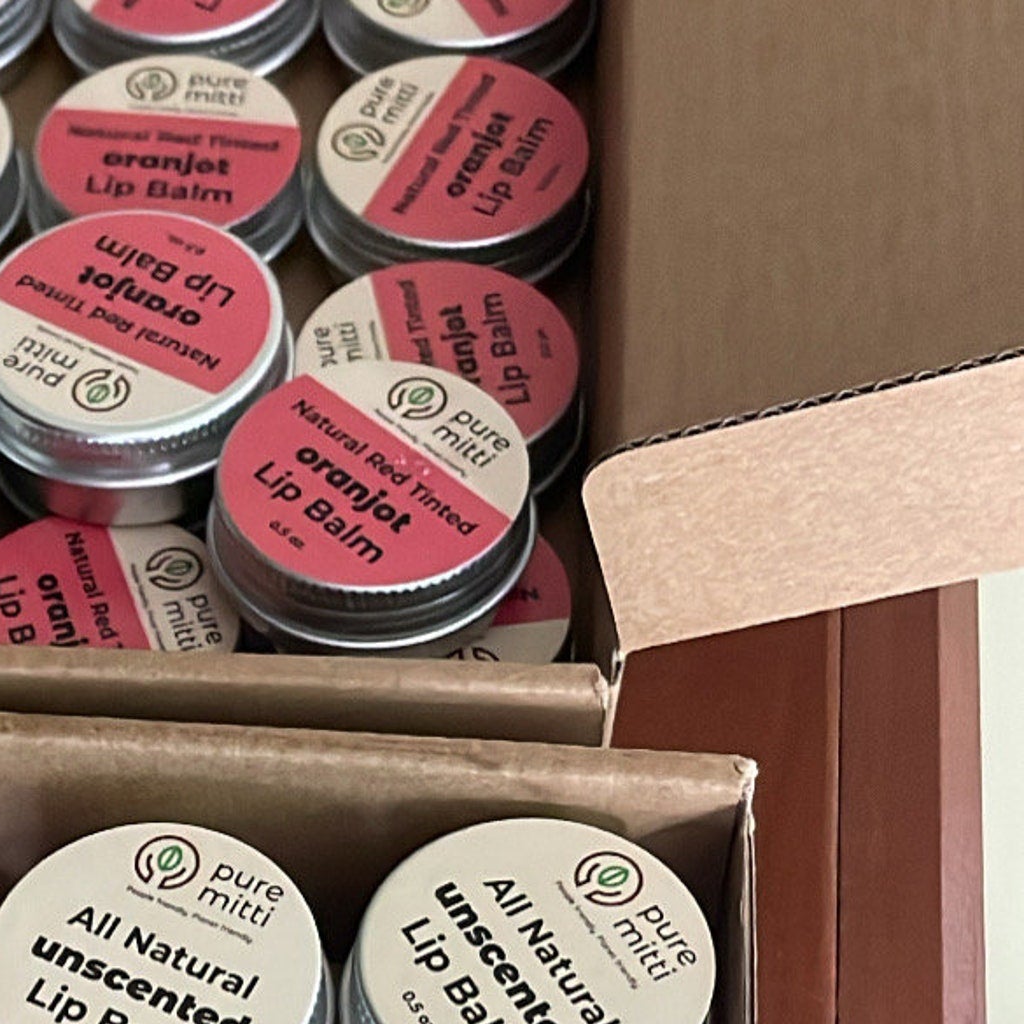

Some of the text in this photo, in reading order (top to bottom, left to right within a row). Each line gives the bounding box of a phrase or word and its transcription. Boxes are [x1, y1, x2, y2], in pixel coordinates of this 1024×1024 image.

[85, 175, 136, 200] Lip
[472, 181, 514, 217] Lip
[94, 234, 179, 283] Balm
[77, 264, 202, 326] oranjot
[183, 273, 236, 308] Lip
[14, 273, 221, 371] Natural Red Tinted
[2, 353, 66, 387] pure
[12, 335, 79, 370] mitti
[431, 424, 497, 468] mitti
[448, 409, 511, 452] pure
[290, 398, 480, 536] Natural Red Tinted
[295, 446, 411, 534] oranjot
[253, 460, 302, 502] Lip
[302, 497, 384, 564] Balm
[65, 531, 120, 641] Natural Red
[186, 594, 223, 645] pure
[196, 886, 275, 928] mitti
[208, 863, 284, 903] pure
[481, 879, 534, 918] All
[65, 906, 123, 941] All
[122, 925, 260, 1000] Natural
[400, 916, 451, 973] Lip
[611, 917, 678, 982] mitti
[633, 904, 697, 967] pure
[24, 977, 88, 1024] Lip
[401, 990, 425, 1013] 0.5
